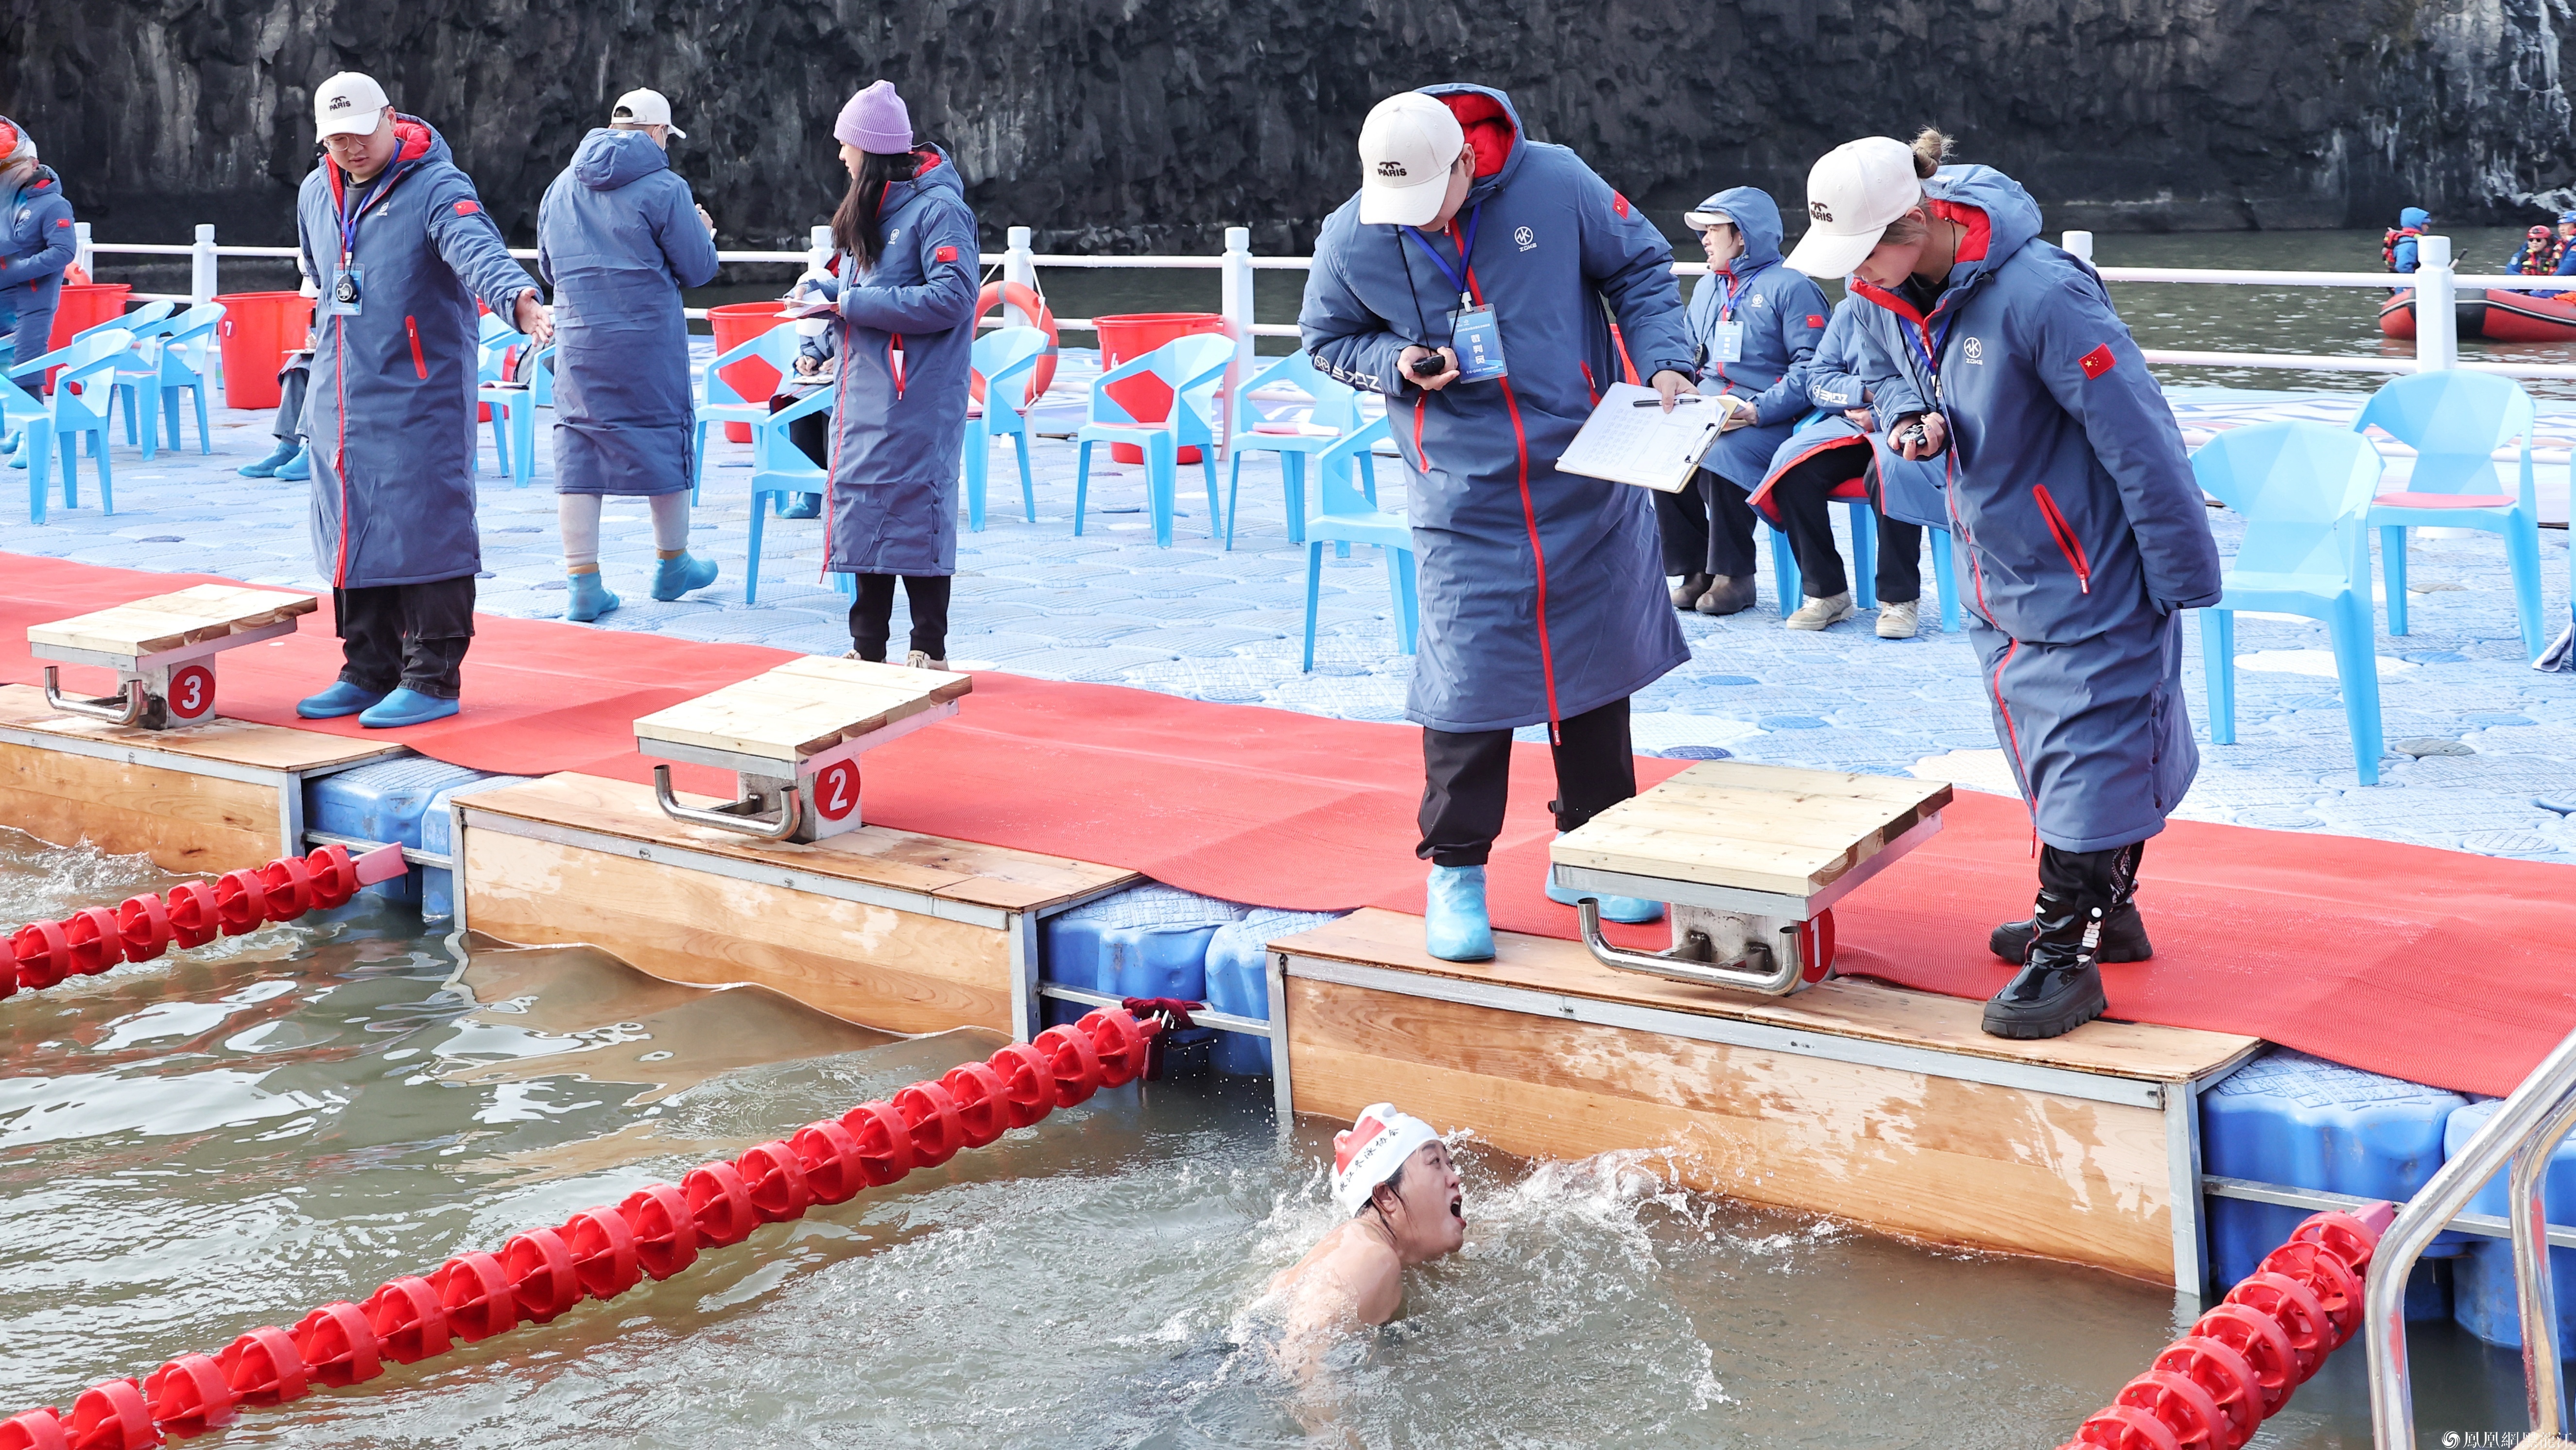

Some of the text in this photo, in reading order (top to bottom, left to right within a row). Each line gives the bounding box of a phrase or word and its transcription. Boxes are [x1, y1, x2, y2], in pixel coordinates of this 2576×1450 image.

[329, 101, 350, 111] PARIS
[1377, 168, 1407, 176] PARIS
[1811, 209, 1833, 222] PARIS
[1519, 243, 1537, 252] ZOKE
[225, 321, 232, 336] 7
[1470, 333, 1485, 365] 裁判员
[1111, 352, 1119, 369] 4
[182, 675, 201, 710] 3
[829, 768, 847, 811] 2
[1811, 916, 1820, 968] 1
